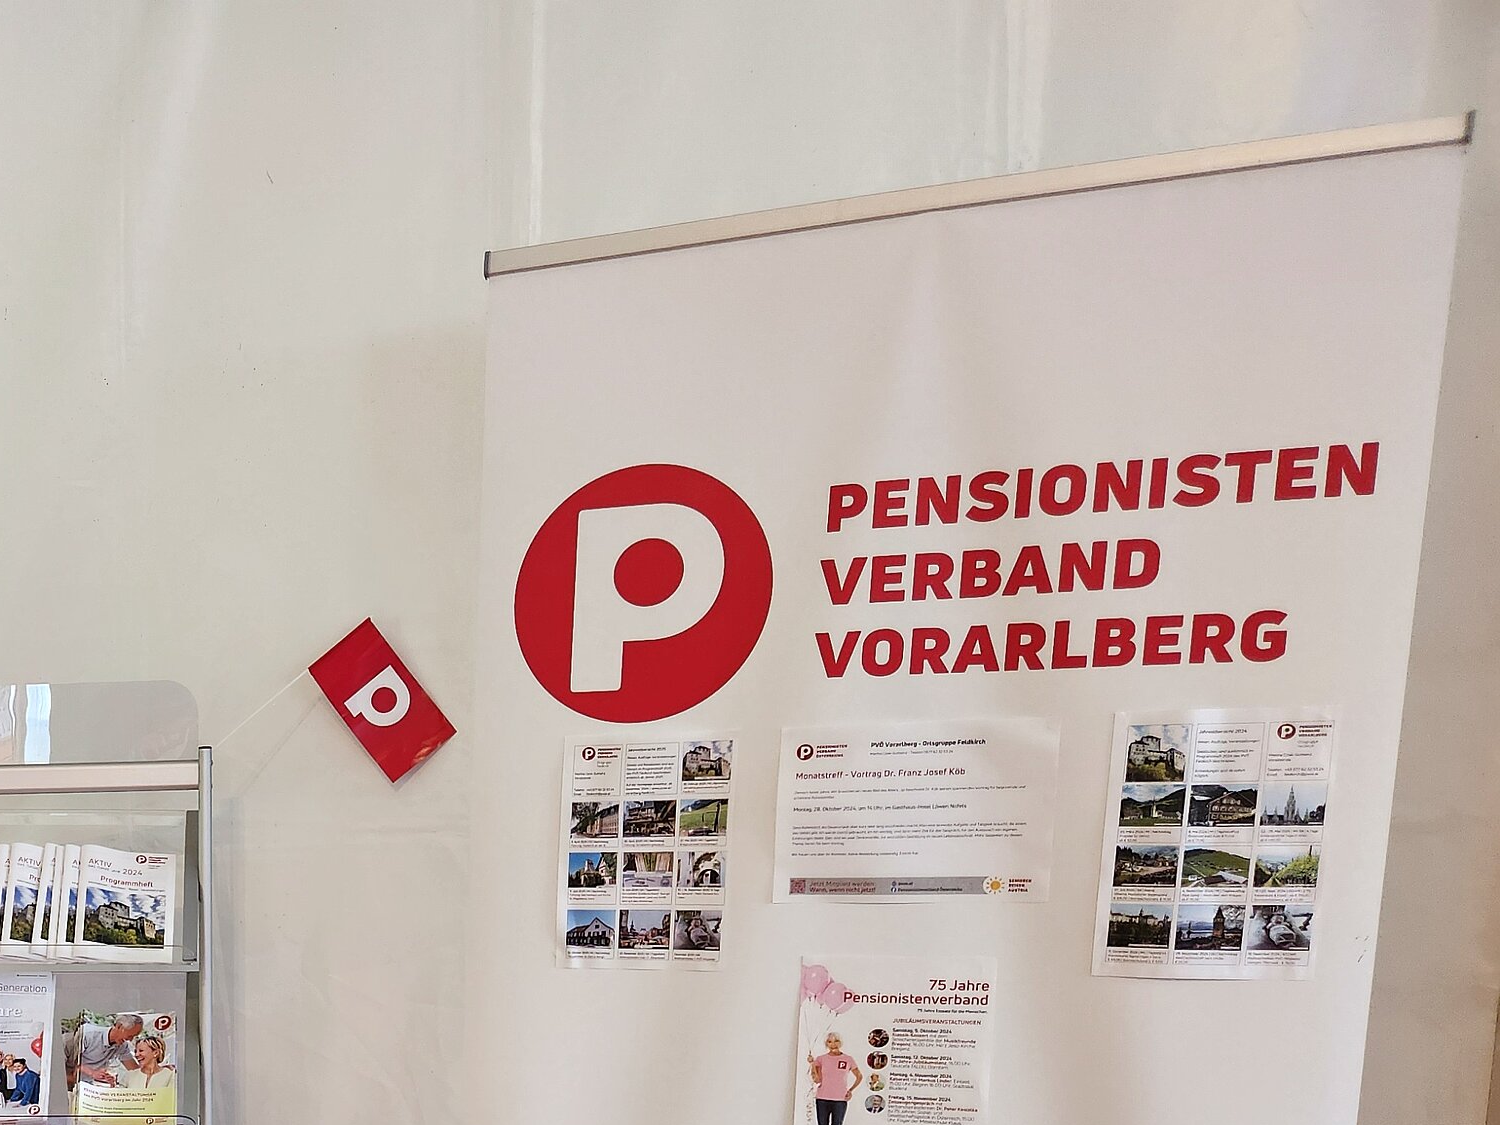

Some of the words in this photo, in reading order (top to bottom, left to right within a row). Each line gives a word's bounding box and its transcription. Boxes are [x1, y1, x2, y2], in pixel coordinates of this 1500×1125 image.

[826, 441, 1381, 533] PENSIONISTEN
[820, 538, 1162, 606] VERBAND
[815, 609, 1289, 679] VORARLBERG
[344, 664, 411, 727] P
[795, 771, 844, 780] Monatstreff
[850, 770, 882, 779] Vortrag
[884, 770, 896, 778] Dr.
[898, 769, 922, 777] Franz
[923, 768, 947, 776] Josef
[948, 767, 966, 776] Köb
[18, 856, 41, 867] AKTIV
[89, 858, 112, 868] AKTIV
[122, 868, 143, 876] 2024
[100, 875, 154, 888] Programmheft
[929, 979, 947, 991] 75
[949, 979, 990, 992] Jahre
[843, 992, 989, 1006] Pensionistenverband
